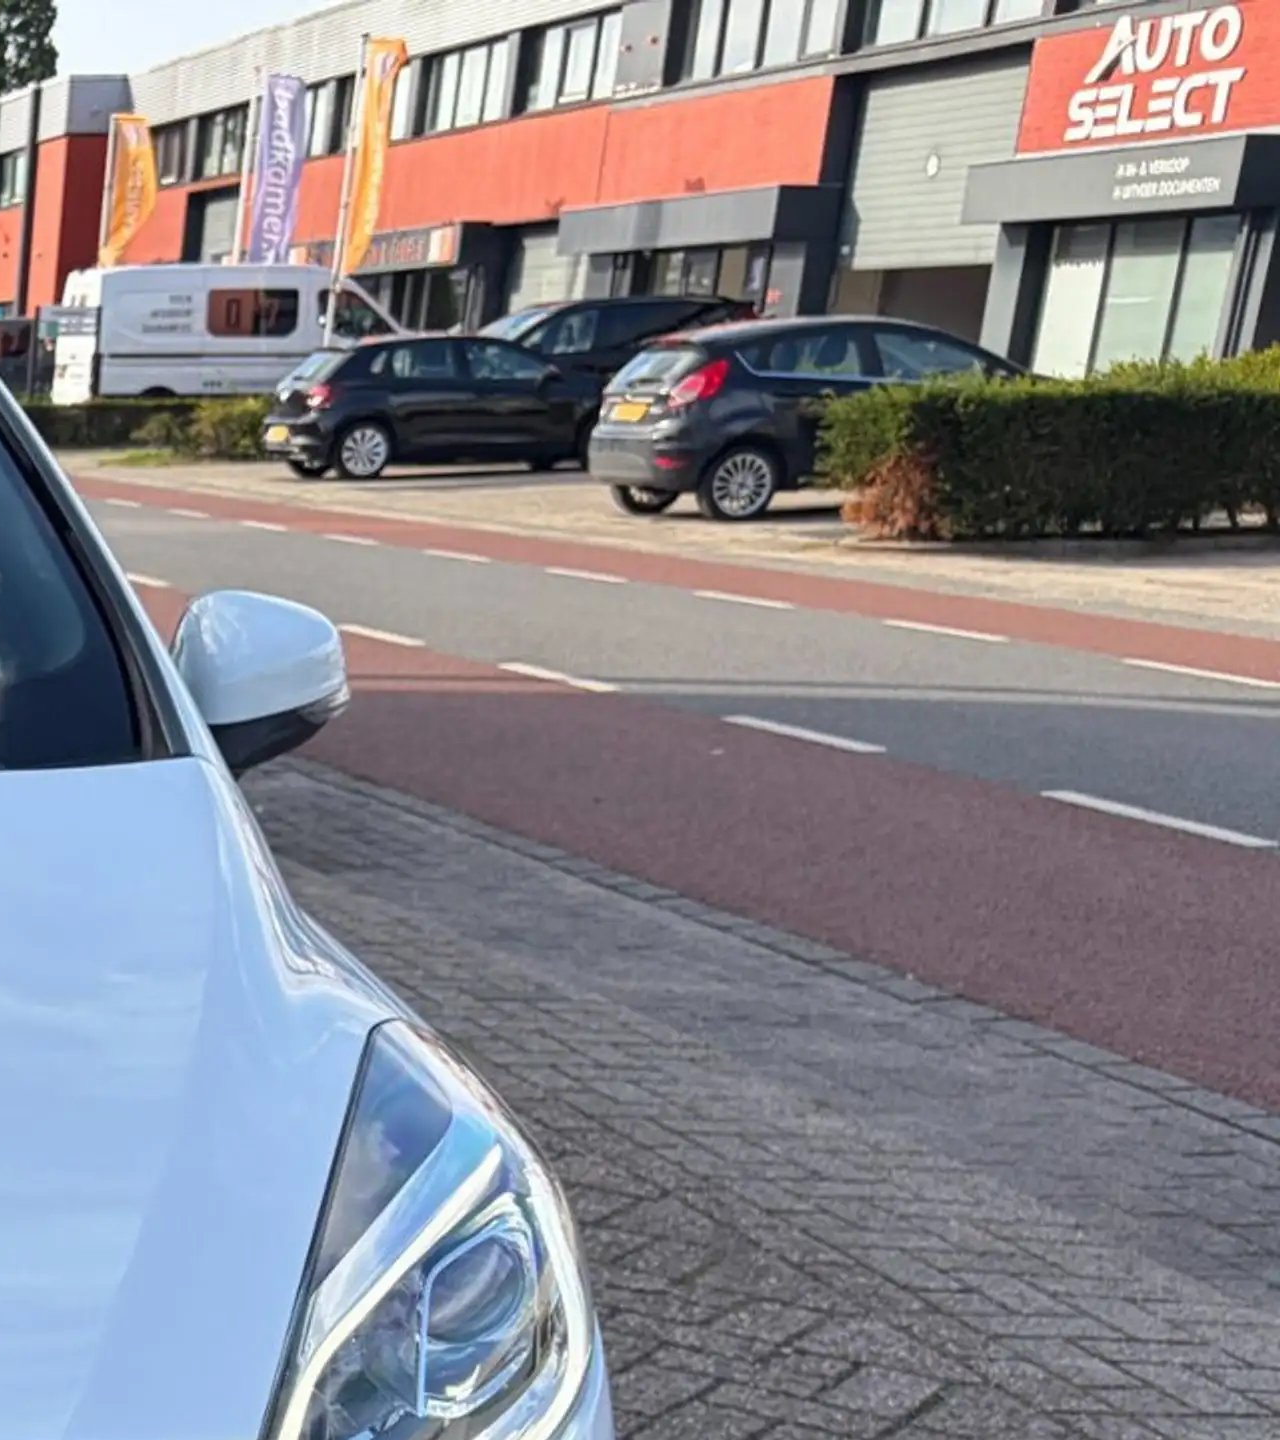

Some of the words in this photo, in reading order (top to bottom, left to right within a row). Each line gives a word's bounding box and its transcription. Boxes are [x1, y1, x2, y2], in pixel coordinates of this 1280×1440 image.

[1084, 5, 1243, 83] AUTO
[1063, 67, 1246, 141] SELECT
[260, 88, 297, 264] badkamer.n
